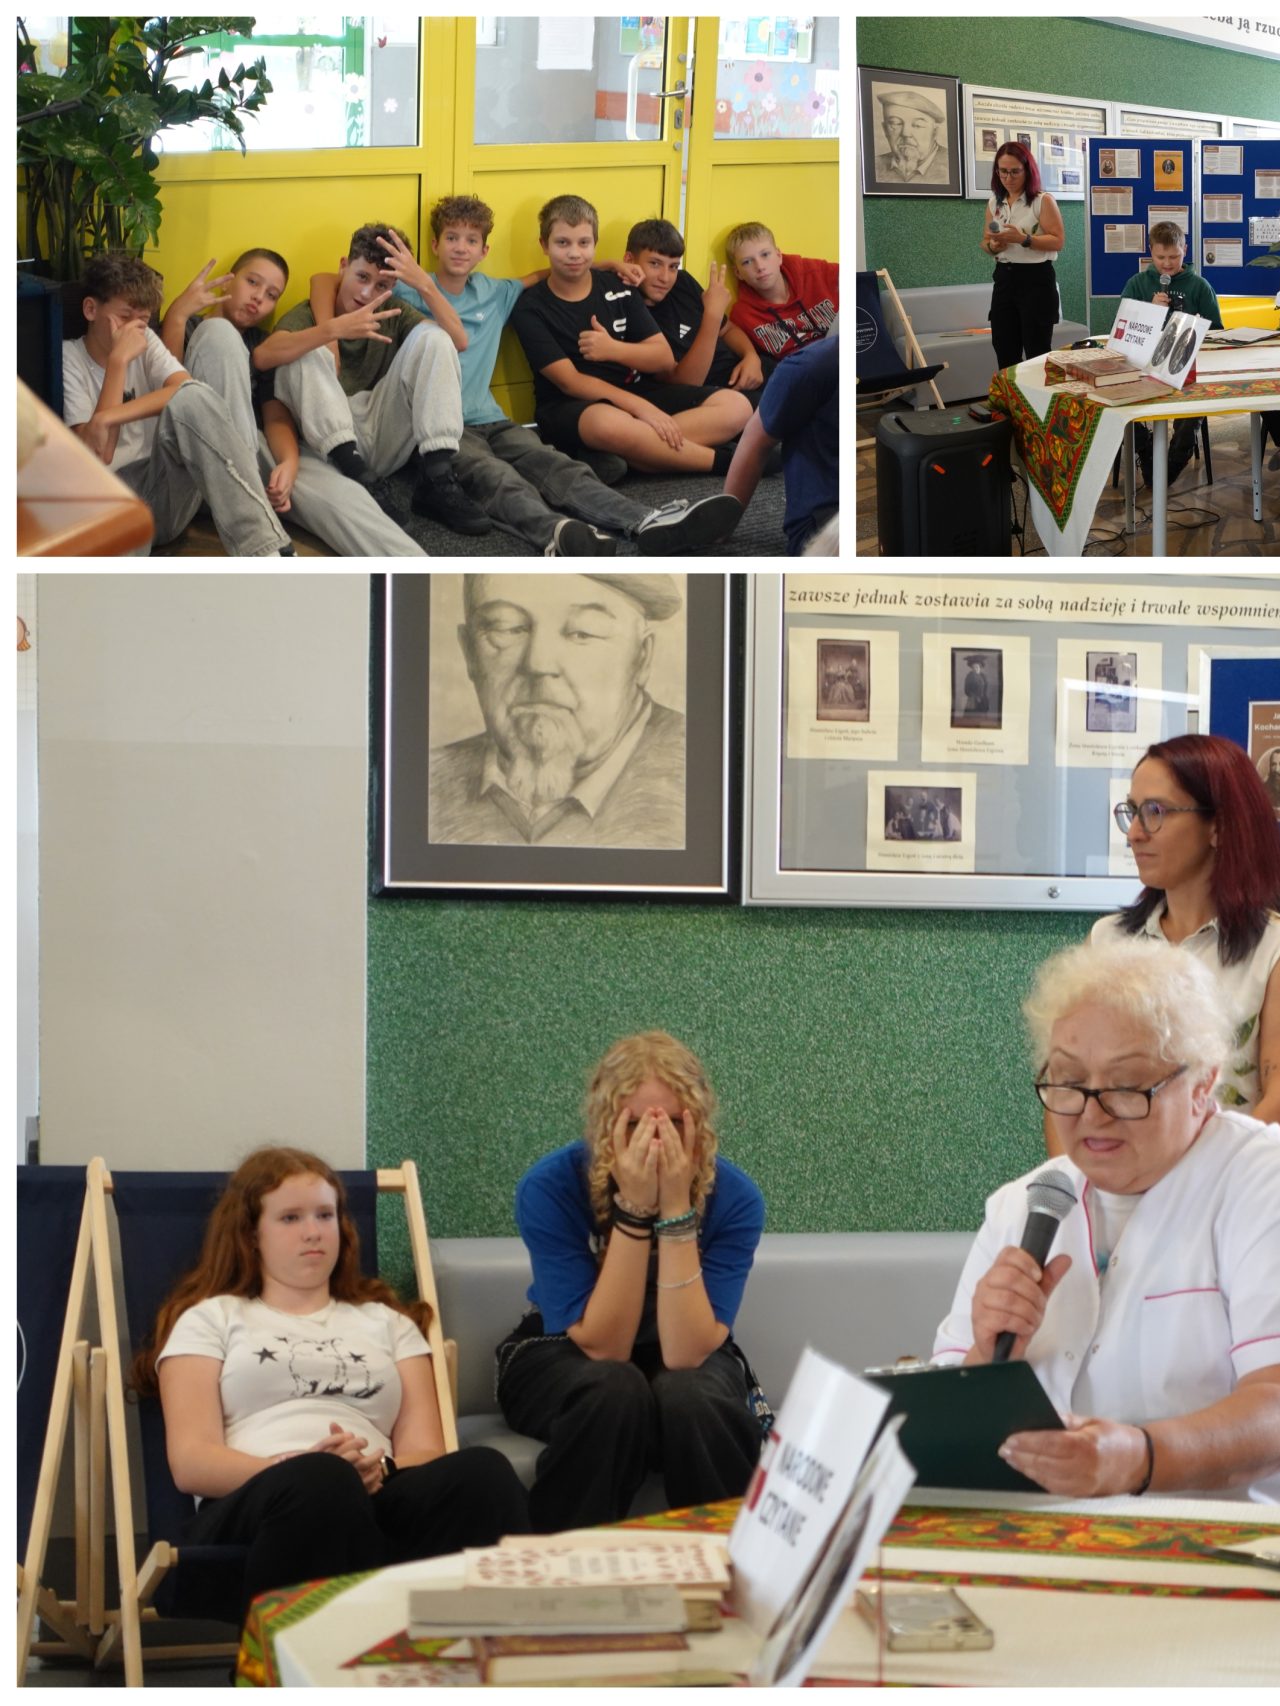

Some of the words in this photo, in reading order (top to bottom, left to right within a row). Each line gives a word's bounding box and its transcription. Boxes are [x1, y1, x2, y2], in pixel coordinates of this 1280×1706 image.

[789, 589, 850, 604] zawsze
[853, 588, 908, 608] jednak
[914, 592, 990, 608] zostawia
[995, 597, 1013, 609] za
[1018, 594, 1054, 613] sobą
[1060, 596, 1126, 617] nadzieję
[1131, 598, 1136, 613] i
[1141, 600, 1190, 615] trwałe
[778, 1443, 834, 1504] NARODOWE
[758, 1491, 807, 1547] CZYTANIE
